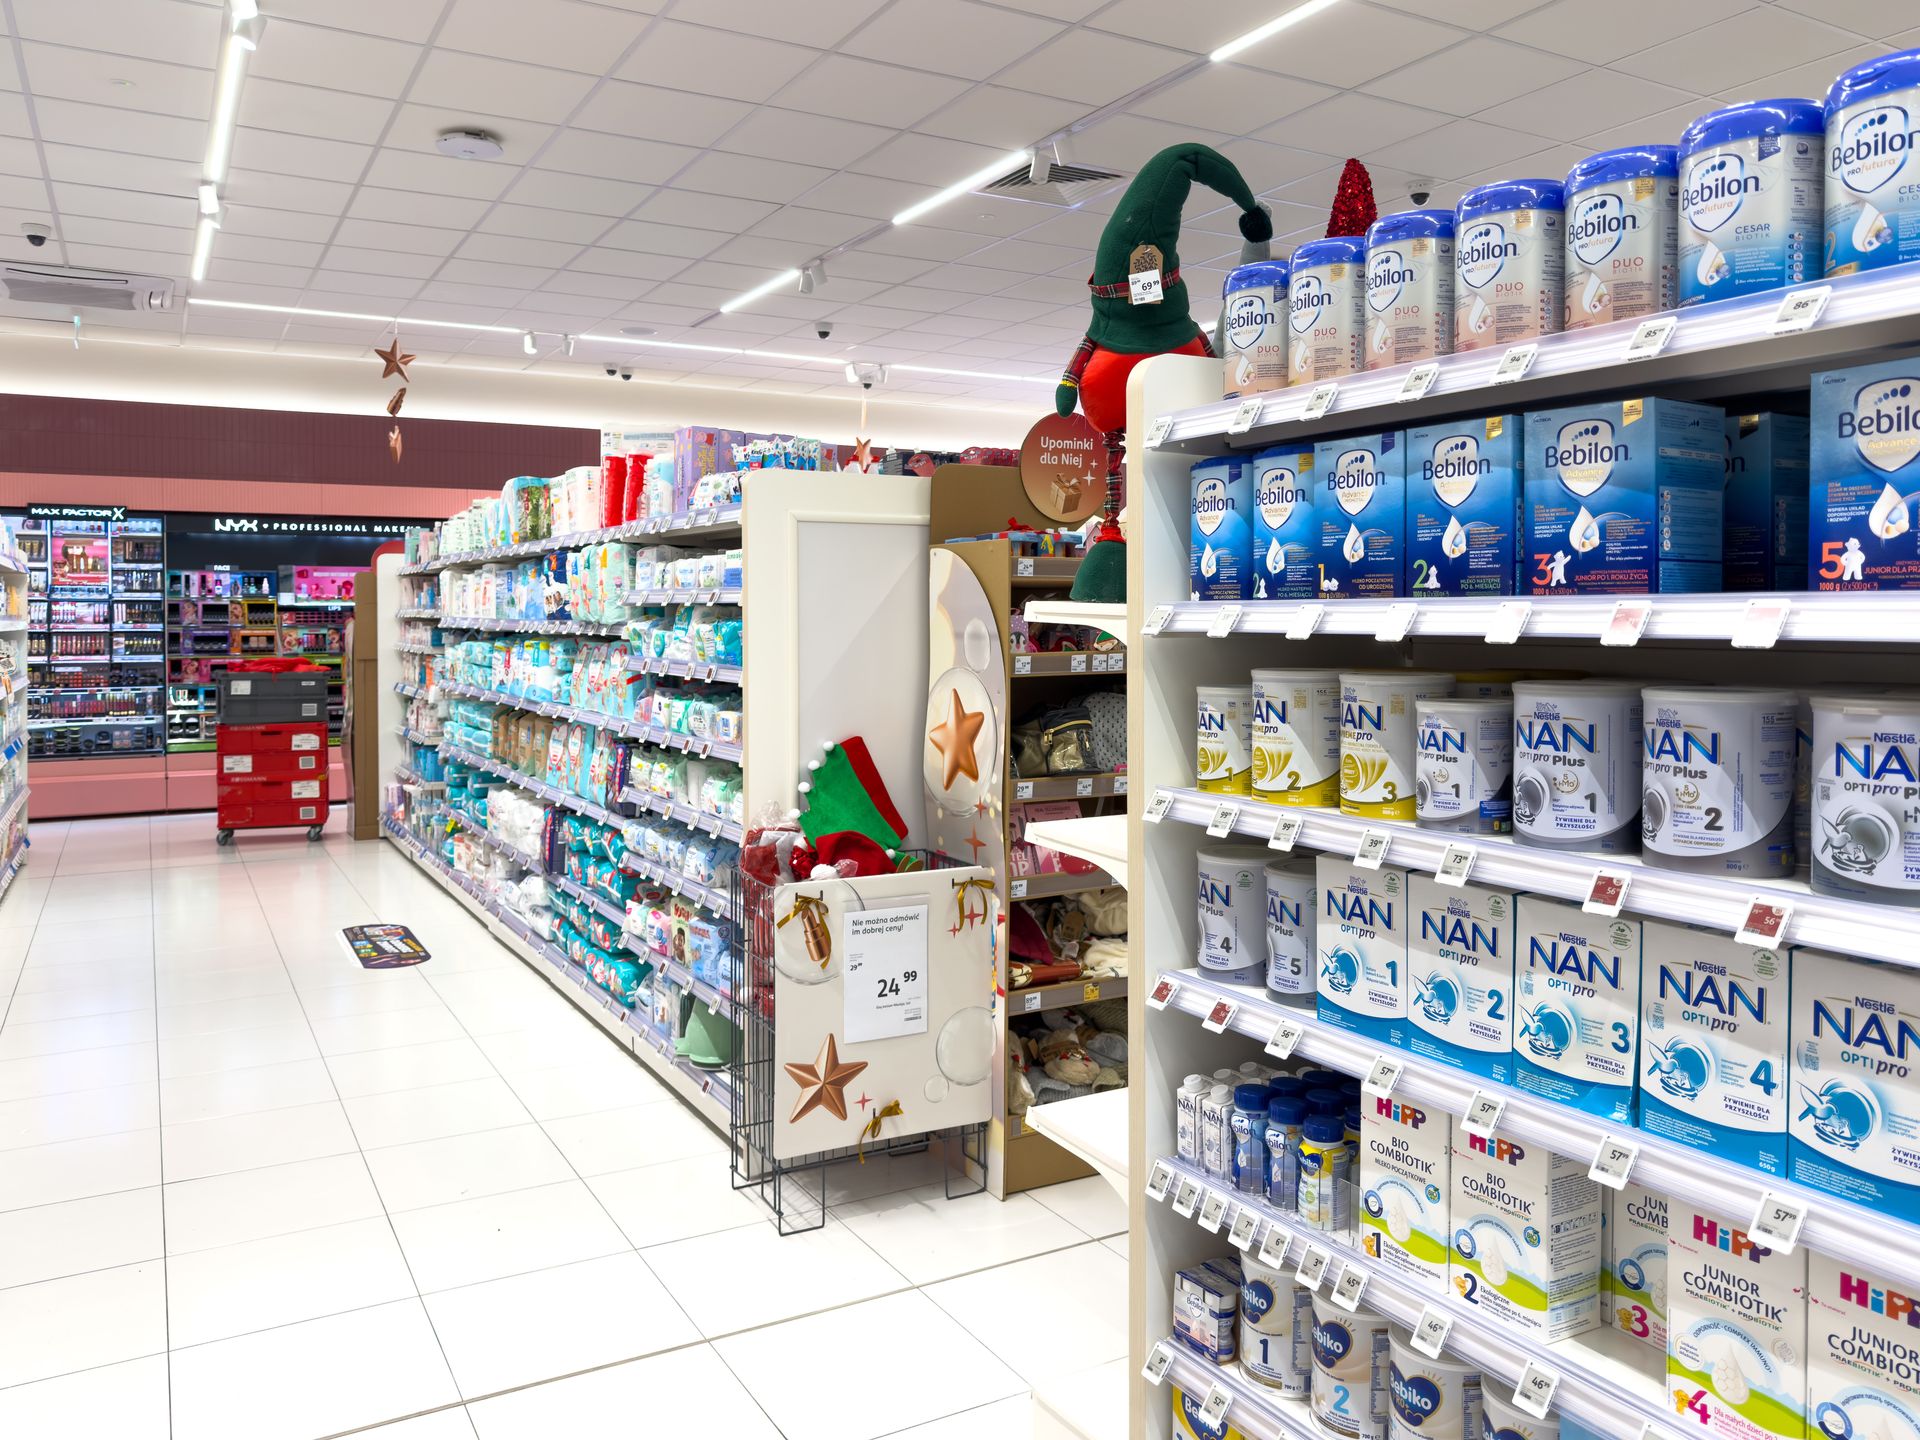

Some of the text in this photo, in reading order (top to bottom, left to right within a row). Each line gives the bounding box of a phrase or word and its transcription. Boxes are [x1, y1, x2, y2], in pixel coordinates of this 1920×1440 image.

[1682, 175, 1759, 211] Bebilon
[1735, 224, 1770, 234] CESAR
[1612, 256, 1644, 269] DUO
[1142, 282, 1152, 290] 69
[1495, 282, 1524, 294] DUO
[1258, 344, 1280, 354] DUO
[1040, 436, 1093, 450] Upominki
[1040, 453, 1083, 469] dla Niej
[1544, 442, 1629, 468] Bebilon
[1422, 457, 1491, 481] Bebilon
[1327, 470, 1386, 491] Bebilon
[1256, 487, 1306, 507] Bebilon
[214, 518, 258, 532] NYX
[273, 522, 367, 532] PROFESSIONAL
[1818, 542, 1845, 579] 5
[1412, 559, 1429, 588] 2
[1532, 554, 1552, 586] 3
[1864, 566, 1891, 574] JUNIOR
[1819, 582, 1834, 590] 1000
[1534, 712, 1560, 721] Nestlé
[1656, 719, 1681, 728] Nestlé
[1761, 716, 1775, 724] 155
[1517, 719, 1594, 754] NAN
[1435, 755, 1458, 763] Plus
[1552, 755, 1585, 767] Plus
[1673, 765, 1707, 779] Plus
[1287, 771, 1302, 791] 2
[1383, 782, 1398, 804] 3
[1451, 783, 1460, 799] 1
[1585, 792, 1596, 814] 1
[1220, 811, 1228, 819] 99
[1555, 816, 1583, 824] ŻYWIENIE
[1704, 807, 1724, 831] 2
[1282, 823, 1291, 831] 99
[1556, 822, 1595, 830] PRZYSZŁOŚCI
[1368, 839, 1378, 847] 39
[1453, 855, 1462, 864] 73
[1606, 887, 1616, 895] 56
[1206, 906, 1224, 916] Plus
[1327, 889, 1392, 930] NAN
[852, 912, 920, 927] Nie można odmówić
[1764, 916, 1775, 925] 56
[862, 926, 884, 936] dobrej
[886, 924, 904, 933] ceny!
[1422, 911, 1497, 957] NAN
[1220, 936, 1232, 953] 4
[1559, 933, 1586, 946] Nestlé
[1290, 958, 1300, 976] 5
[1530, 936, 1619, 990] NAN
[1693, 960, 1727, 976] Nestlé
[1385, 960, 1397, 988] 1
[877, 970, 917, 998] 24 99
[1368, 990, 1386, 1000] ŻYWIENIE
[1659, 964, 1765, 1024] NAN
[1487, 989, 1505, 1021] 2
[1855, 996, 1896, 1014] Nestlé
[1281, 1030, 1290, 1038] 56
[1469, 1022, 1490, 1032] ŻYWIENIE
[1612, 1022, 1630, 1054] 3
[1586, 1054, 1626, 1070] ŻYWIENIE DLA
[1587, 1062, 1624, 1076] PRZYSZŁOŚCI
[1380, 1067, 1389, 1076] 57
[1750, 1059, 1778, 1096] 4
[1376, 1096, 1426, 1130] HiPP
[1480, 1103, 1490, 1112] 57
[1723, 1096, 1770, 1115] ŻYWIENIE DLA
[1724, 1104, 1769, 1121] PRZYSZŁOŚCI
[1392, 1137, 1409, 1152] BIO
[1370, 1139, 1433, 1174] COMBIOTIK
[1610, 1150, 1622, 1160] 57
[1375, 1158, 1426, 1184] MLEKO POCZĄTKOWE
[1487, 1173, 1506, 1188] BIO
[1462, 1176, 1532, 1216] COMBIOTIK
[1773, 1208, 1788, 1221] 57
[1371, 1232, 1381, 1258] 1
[1384, 1240, 1409, 1258] Ekologiczne
[1346, 1277, 1355, 1286] 45
[1703, 1263, 1760, 1297] JUNIOR
[1480, 1286, 1510, 1305] Ekologiczne
[1683, 1271, 1783, 1323] COMBIOTIK
[1685, 1288, 1728, 1310] PRAEBIOTIK
[1738, 1310, 1782, 1332] PROBIOTIK
[1427, 1320, 1438, 1332] 46
[1631, 1305, 1649, 1338] 3
[1724, 1325, 1750, 1343] COMPLEX
[1259, 1338, 1269, 1364] 1
[1851, 1326, 1920, 1366] JUNIOR
[1830, 1352, 1881, 1378] PRAEBIOTIK
[1531, 1376, 1543, 1390] 46
[1213, 1396, 1222, 1406] 52
[1333, 1385, 1350, 1415] 2
[1688, 1390, 1711, 1425] 4
[1714, 1407, 1724, 1417] Dla
[1724, 1412, 1746, 1428] małych
[1746, 1421, 1763, 1437] dzieci
